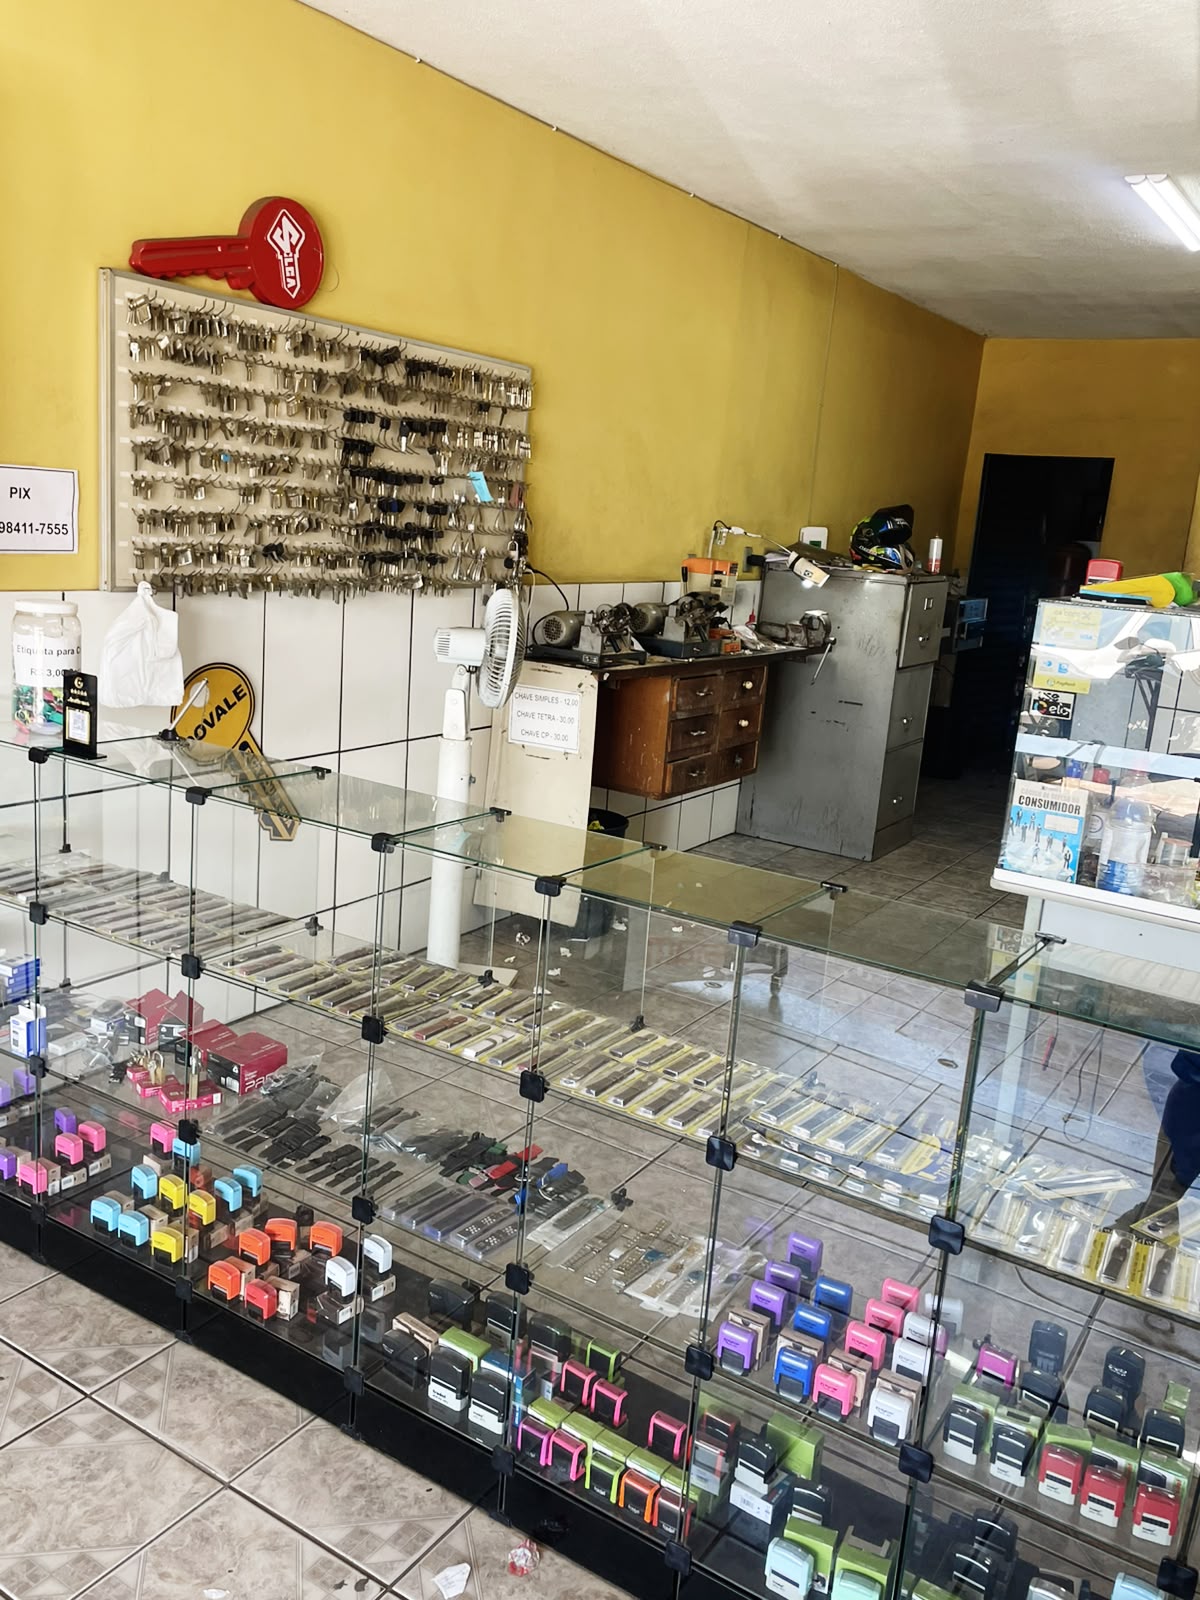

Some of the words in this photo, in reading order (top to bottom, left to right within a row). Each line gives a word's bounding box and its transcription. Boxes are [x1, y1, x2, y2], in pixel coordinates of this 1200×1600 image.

[9, 486, 31, 500] PIX
[56, 648, 75, 657] para
[514, 692, 534, 701] CHAVE
[534, 694, 559, 704] SIMPLES
[187, 684, 248, 742] OVALE
[516, 710, 535, 719] CHAVE
[537, 713, 556, 721] TETRA
[520, 729, 539, 738] CHAVE
[541, 731, 549, 739] CP
[1018, 795, 1081, 815] CONSUMIDOR
